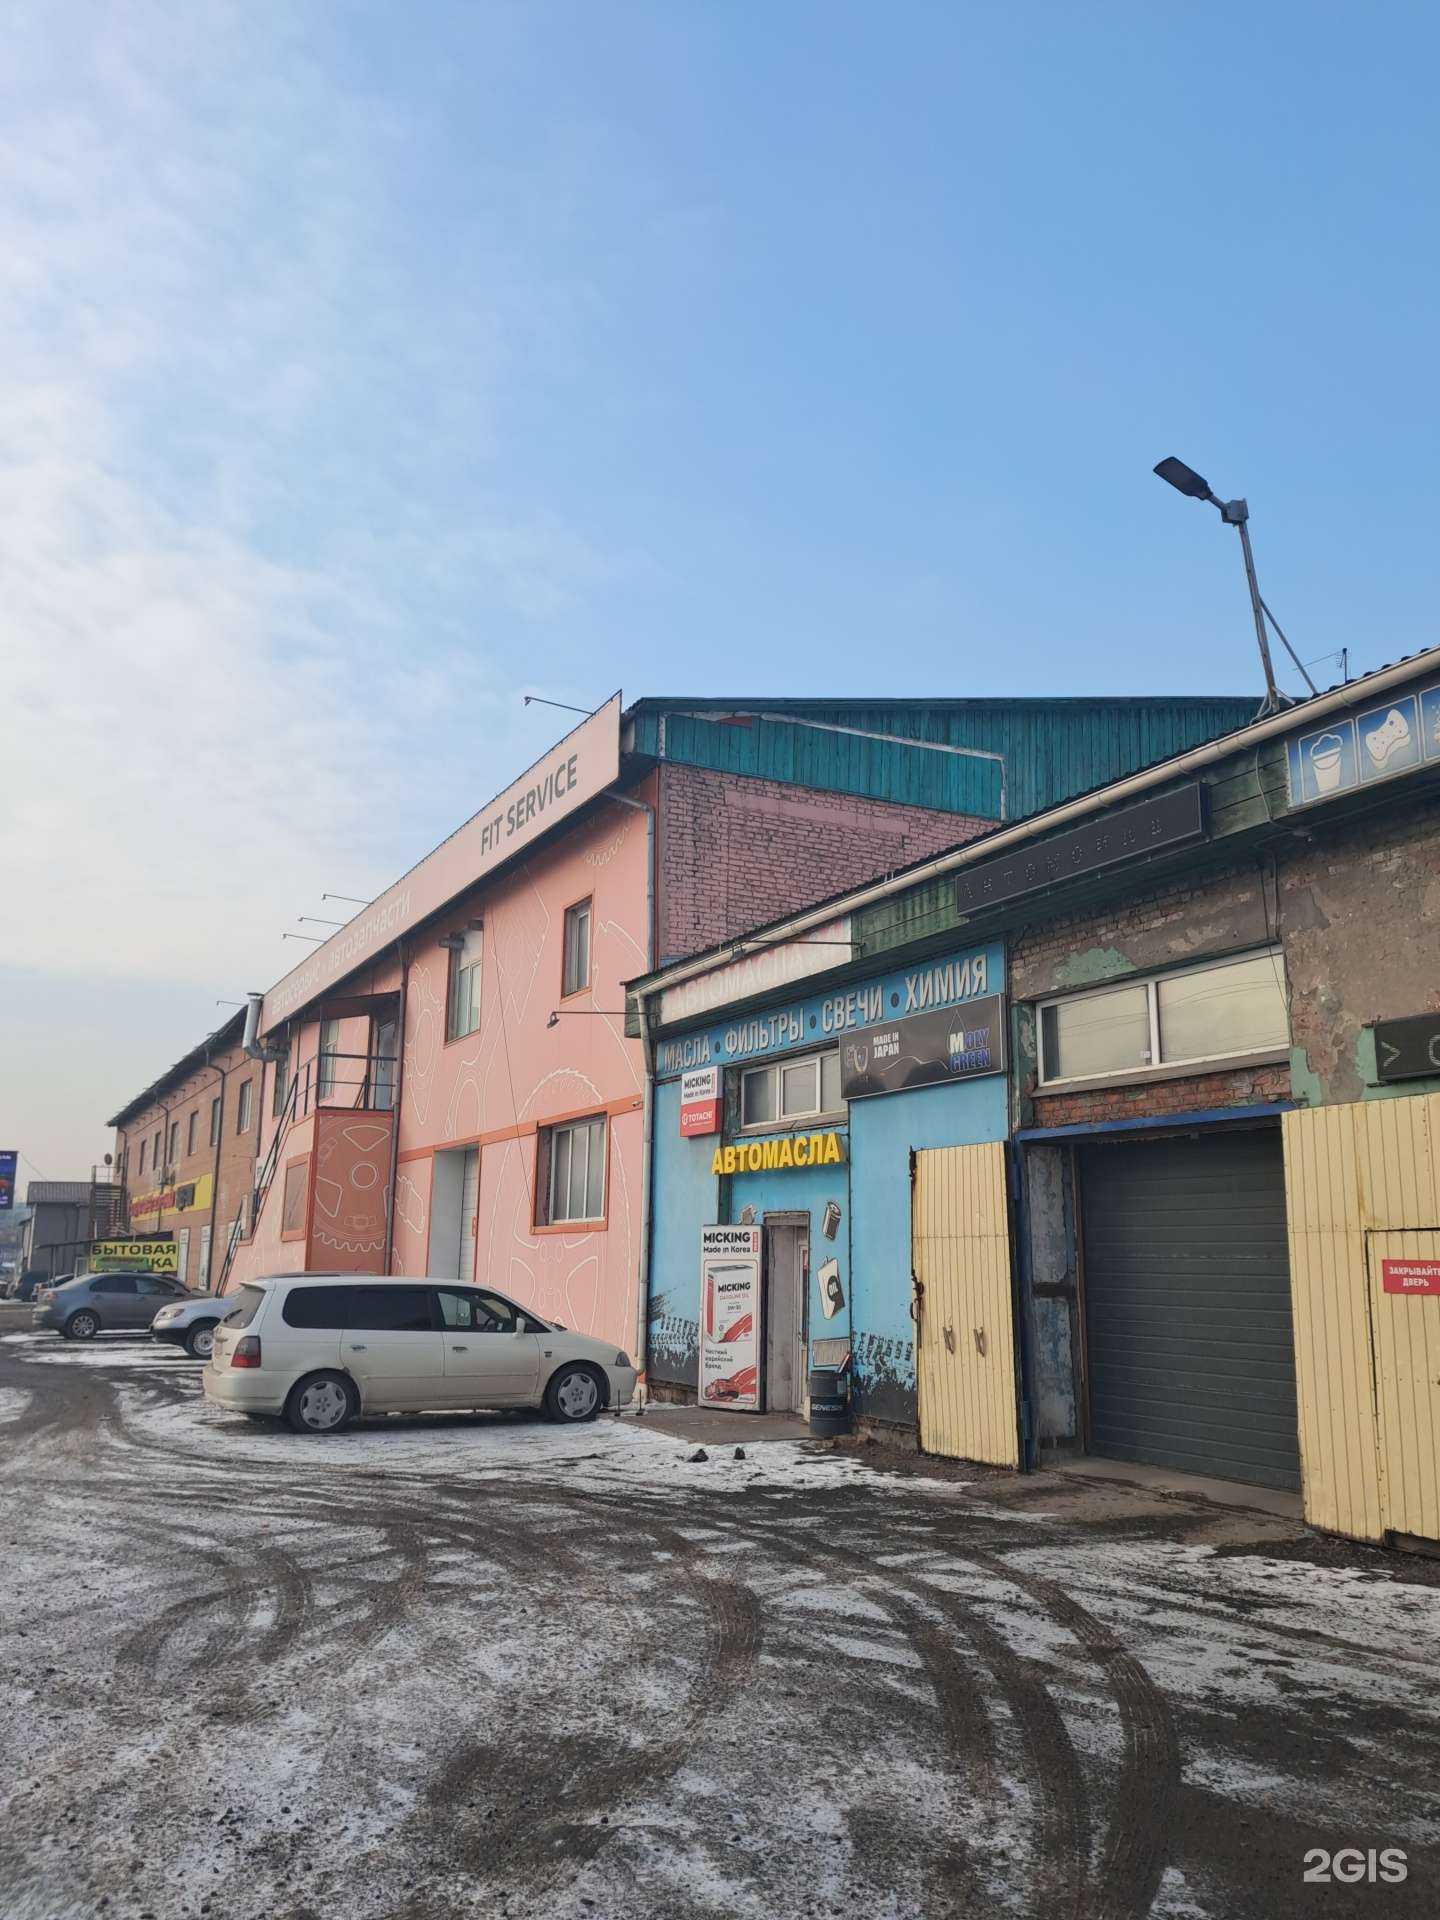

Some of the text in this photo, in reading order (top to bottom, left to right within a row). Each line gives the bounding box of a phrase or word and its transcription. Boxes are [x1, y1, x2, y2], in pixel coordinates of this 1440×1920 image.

[481, 753, 578, 856] FIT SERVICE
[664, 954, 988, 1073] МАСЛА ФИЛЬТРЫ СВЕЧИ ХИМИЯ
[873, 1032, 899, 1046] MADE IN
[874, 1042, 900, 1058] JAPAN
[951, 1048, 991, 1073] GREEN
[684, 1074, 711, 1089] MICKING
[711, 1132, 840, 1175] АВТОМАСЛА
[703, 1232, 750, 1244] MICKING
[92, 1244, 177, 1255] БЫТОВАЯ
[718, 1282, 751, 1293] MICKING
[1403, 1277, 1430, 1287] ДВЕРЬ
